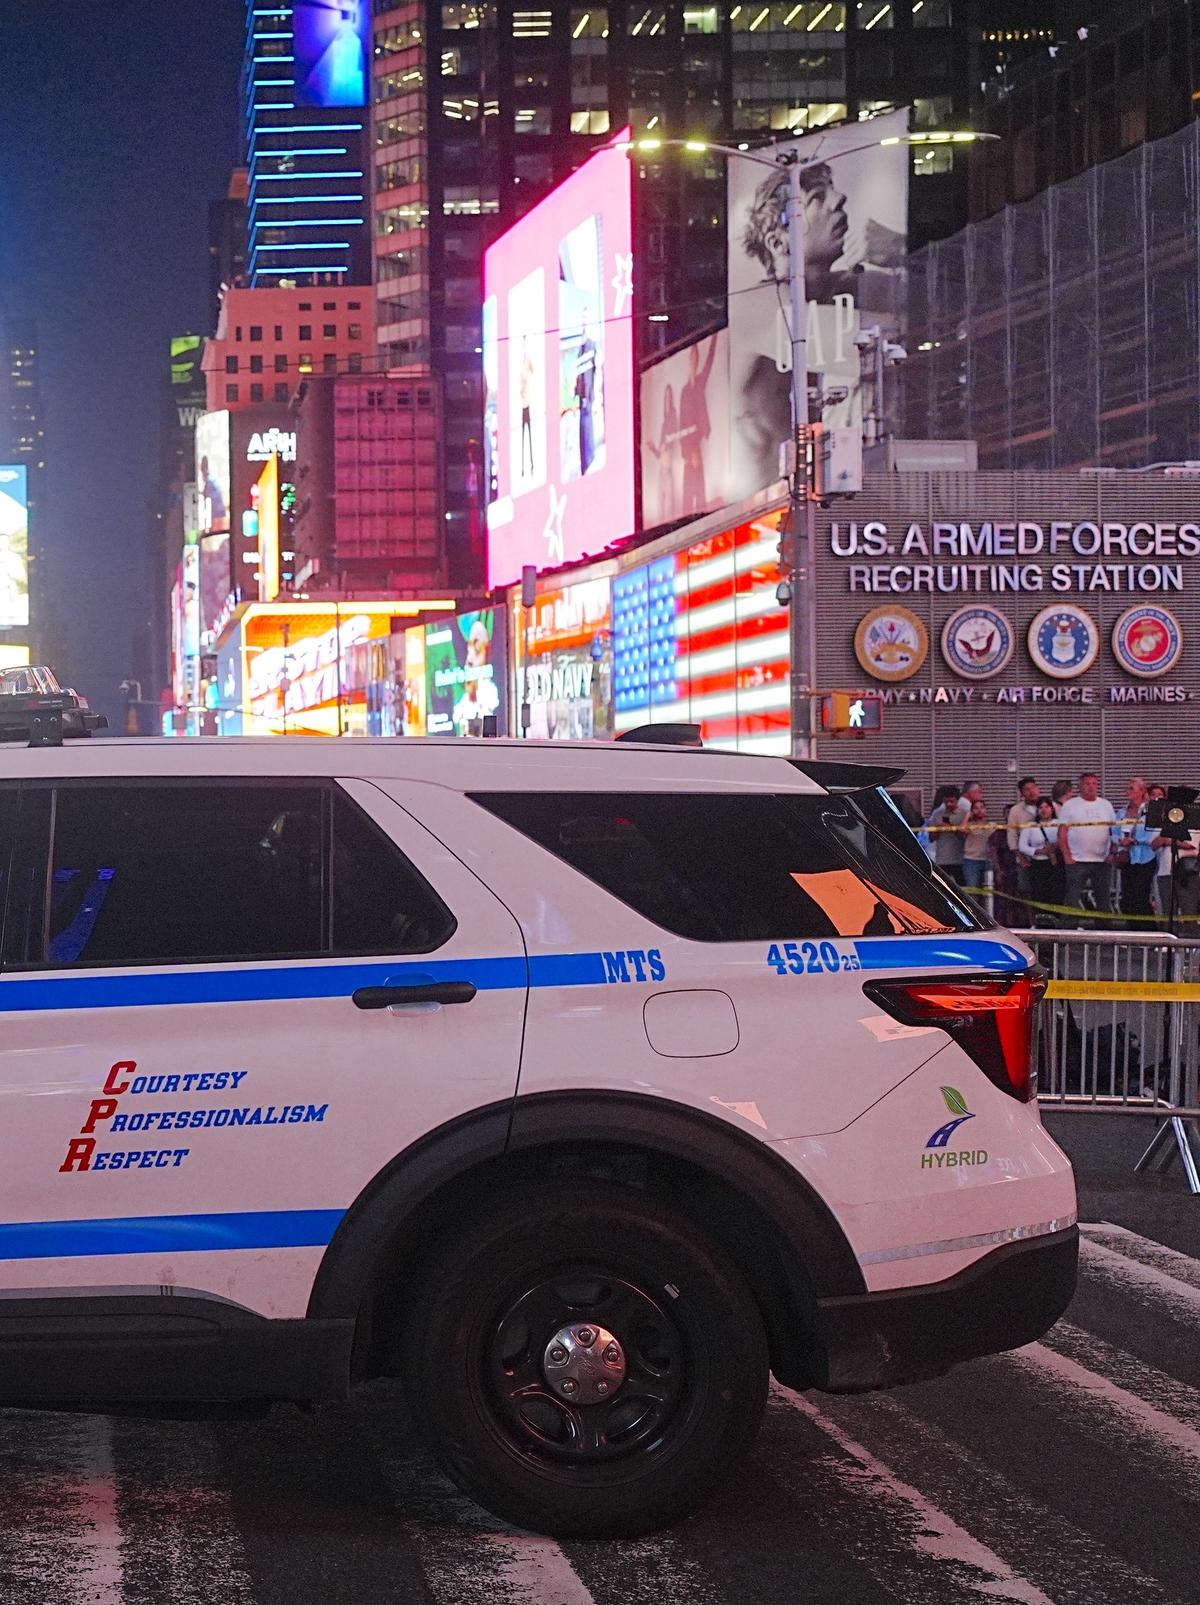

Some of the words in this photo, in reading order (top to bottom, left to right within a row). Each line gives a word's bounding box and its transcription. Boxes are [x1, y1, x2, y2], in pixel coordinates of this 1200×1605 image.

[830, 521, 896, 557] U.S.
[901, 521, 1045, 557] ARMED
[1050, 521, 1200, 557] FORCES
[850, 564, 1044, 593] RECRUITING
[1051, 563, 1184, 593] STATION
[551, 662, 594, 701] NAVY
[919, 686, 975, 703] NAVY
[996, 686, 1025, 703] AIR
[1031, 686, 1093, 703] FORCE
[1110, 686, 1186, 703] MARINES
[601, 949, 666, 984] MTS
[102, 1060, 248, 1096] COURTESY
[80, 1098, 330, 1135] PROFESSIONALISM
[58, 1137, 191, 1173] RESPECT
[921, 1149, 989, 1169] HYBRID
